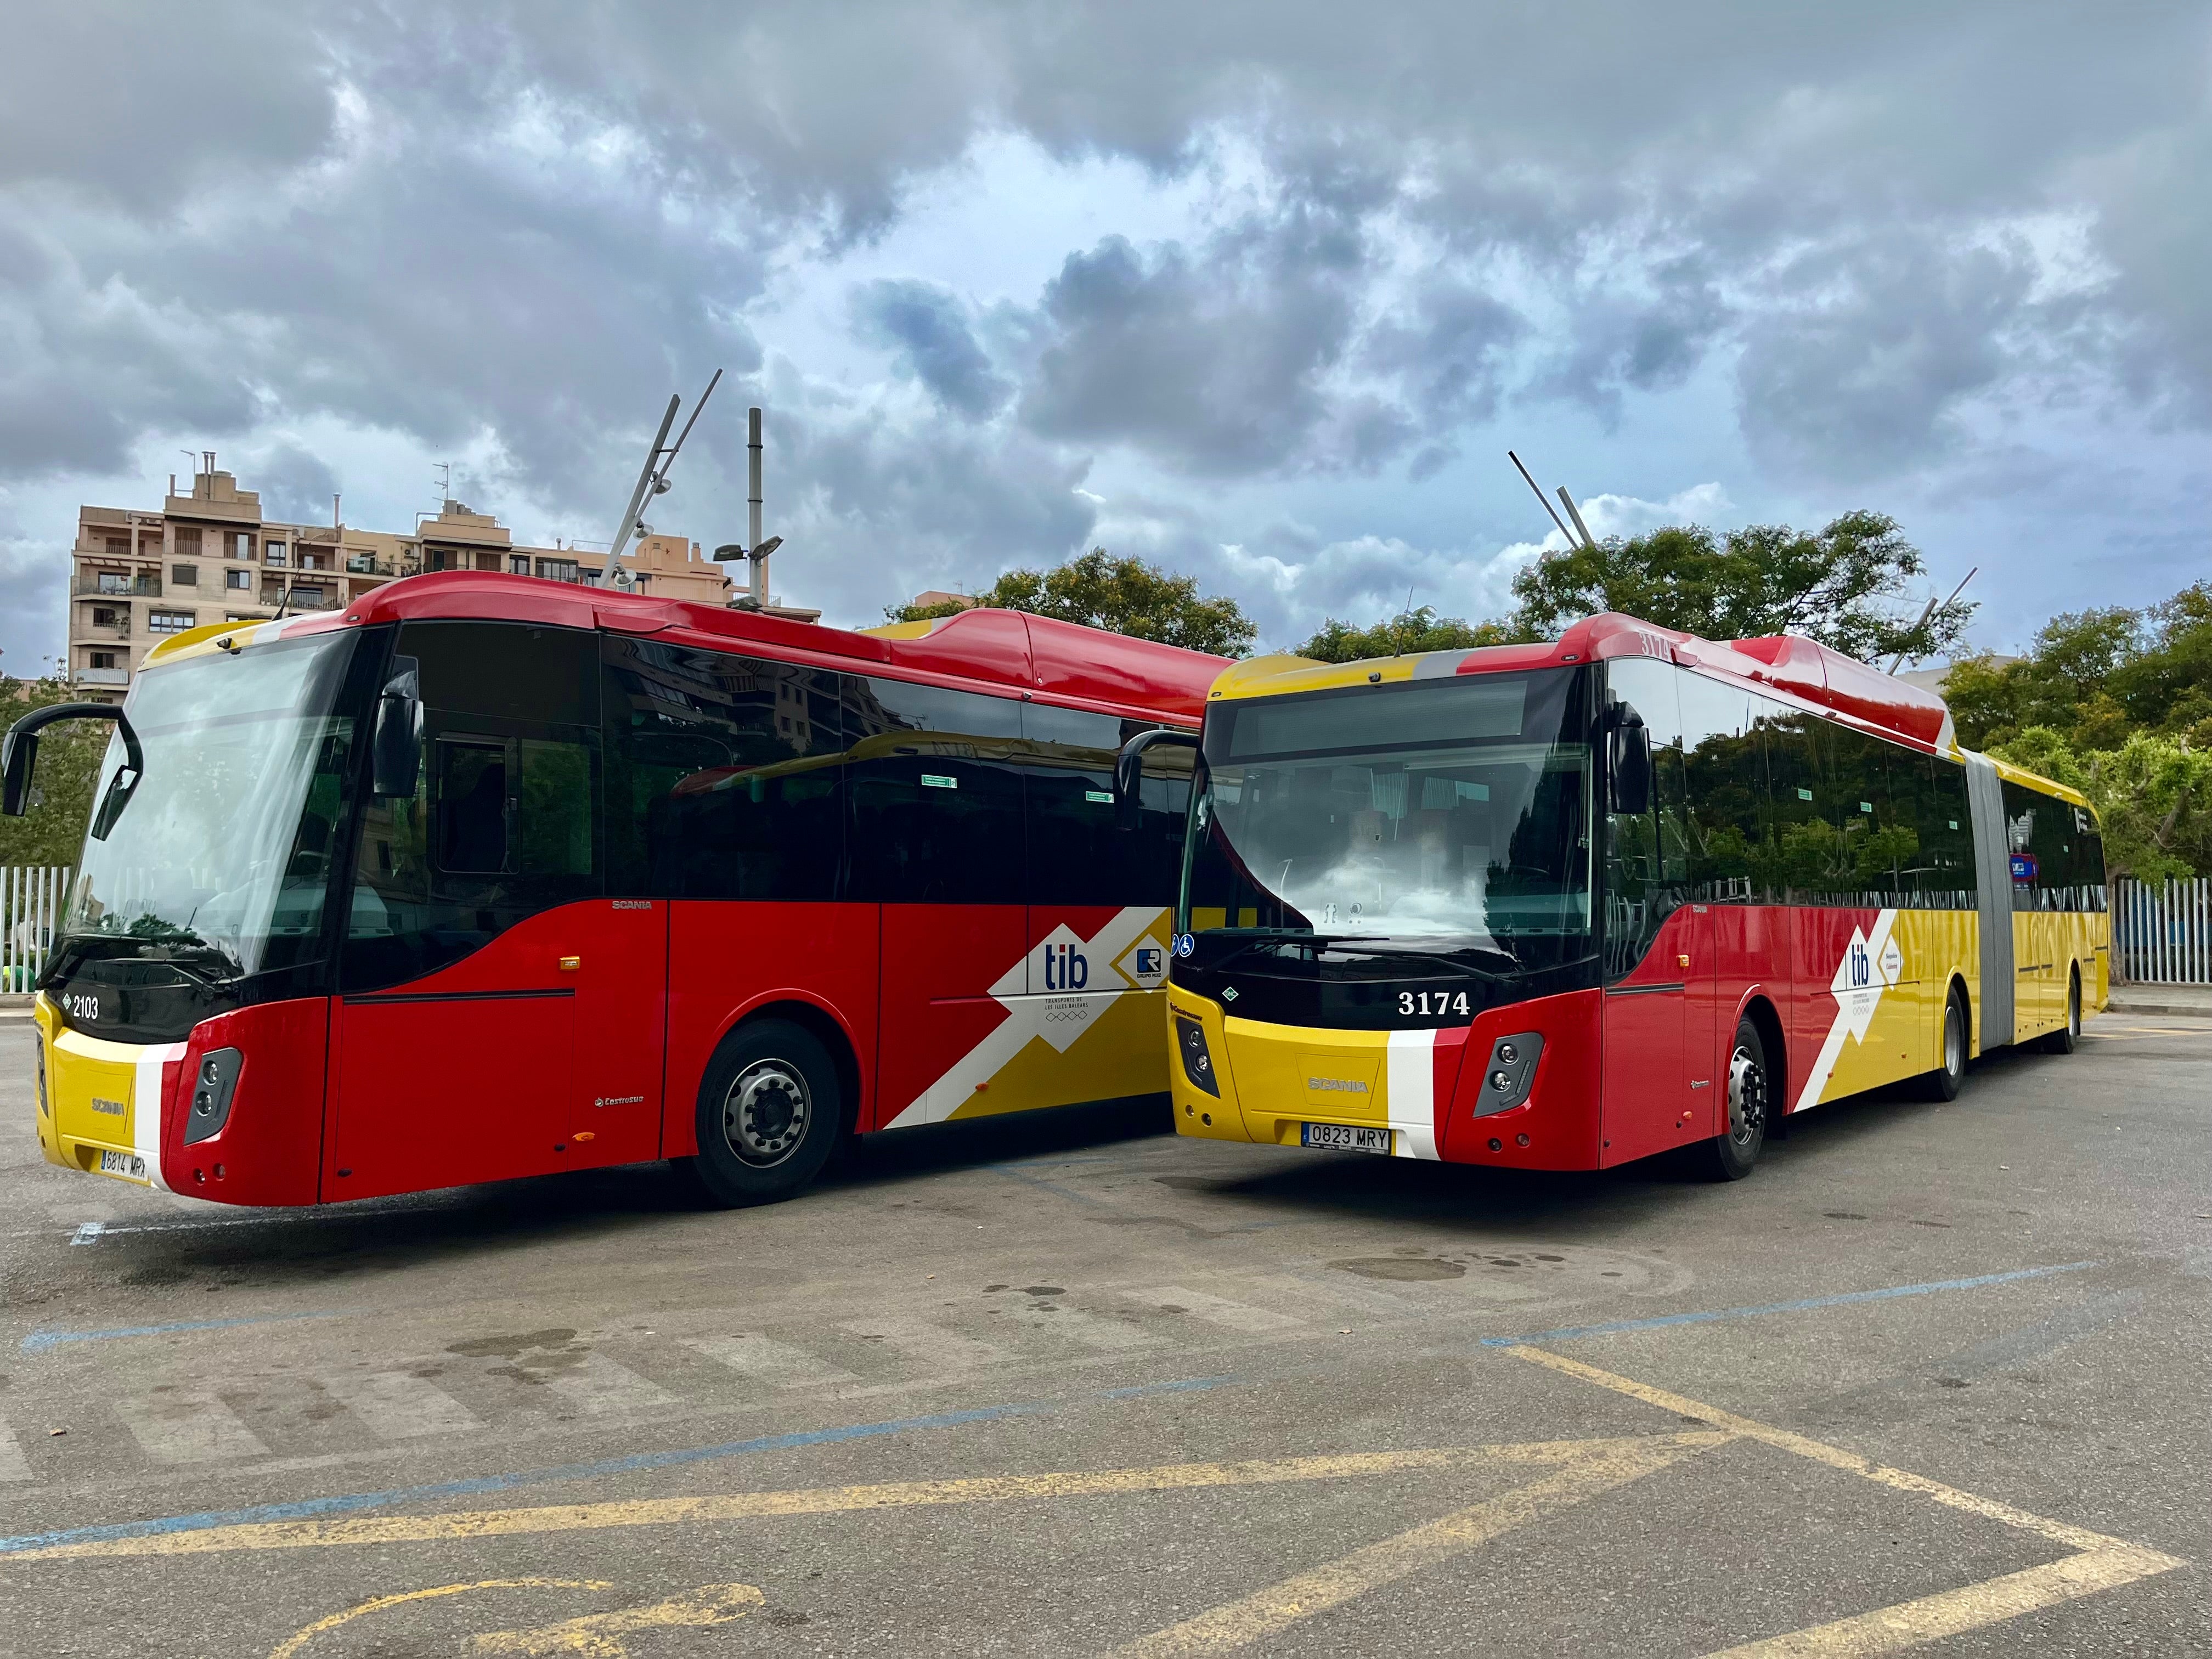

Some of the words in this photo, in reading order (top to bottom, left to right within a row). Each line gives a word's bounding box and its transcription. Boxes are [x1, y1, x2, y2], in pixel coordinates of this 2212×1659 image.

[1639, 632, 1672, 661] 3174
[612, 900, 652, 910] SCANIA
[1045, 944, 1088, 990] tib
[1852, 944, 1869, 986] tib
[73, 995, 98, 1020] 2103
[1398, 992, 1470, 1015] 3174
[1308, 1077, 1369, 1093] SCANIA
[605, 1096, 644, 1105] Castrosua
[1313, 1126, 1351, 1144] 0823
[1357, 1129, 1387, 1148] MRY
[106, 1152, 126, 1173] 6814
[130, 1156, 145, 1178] MRX
